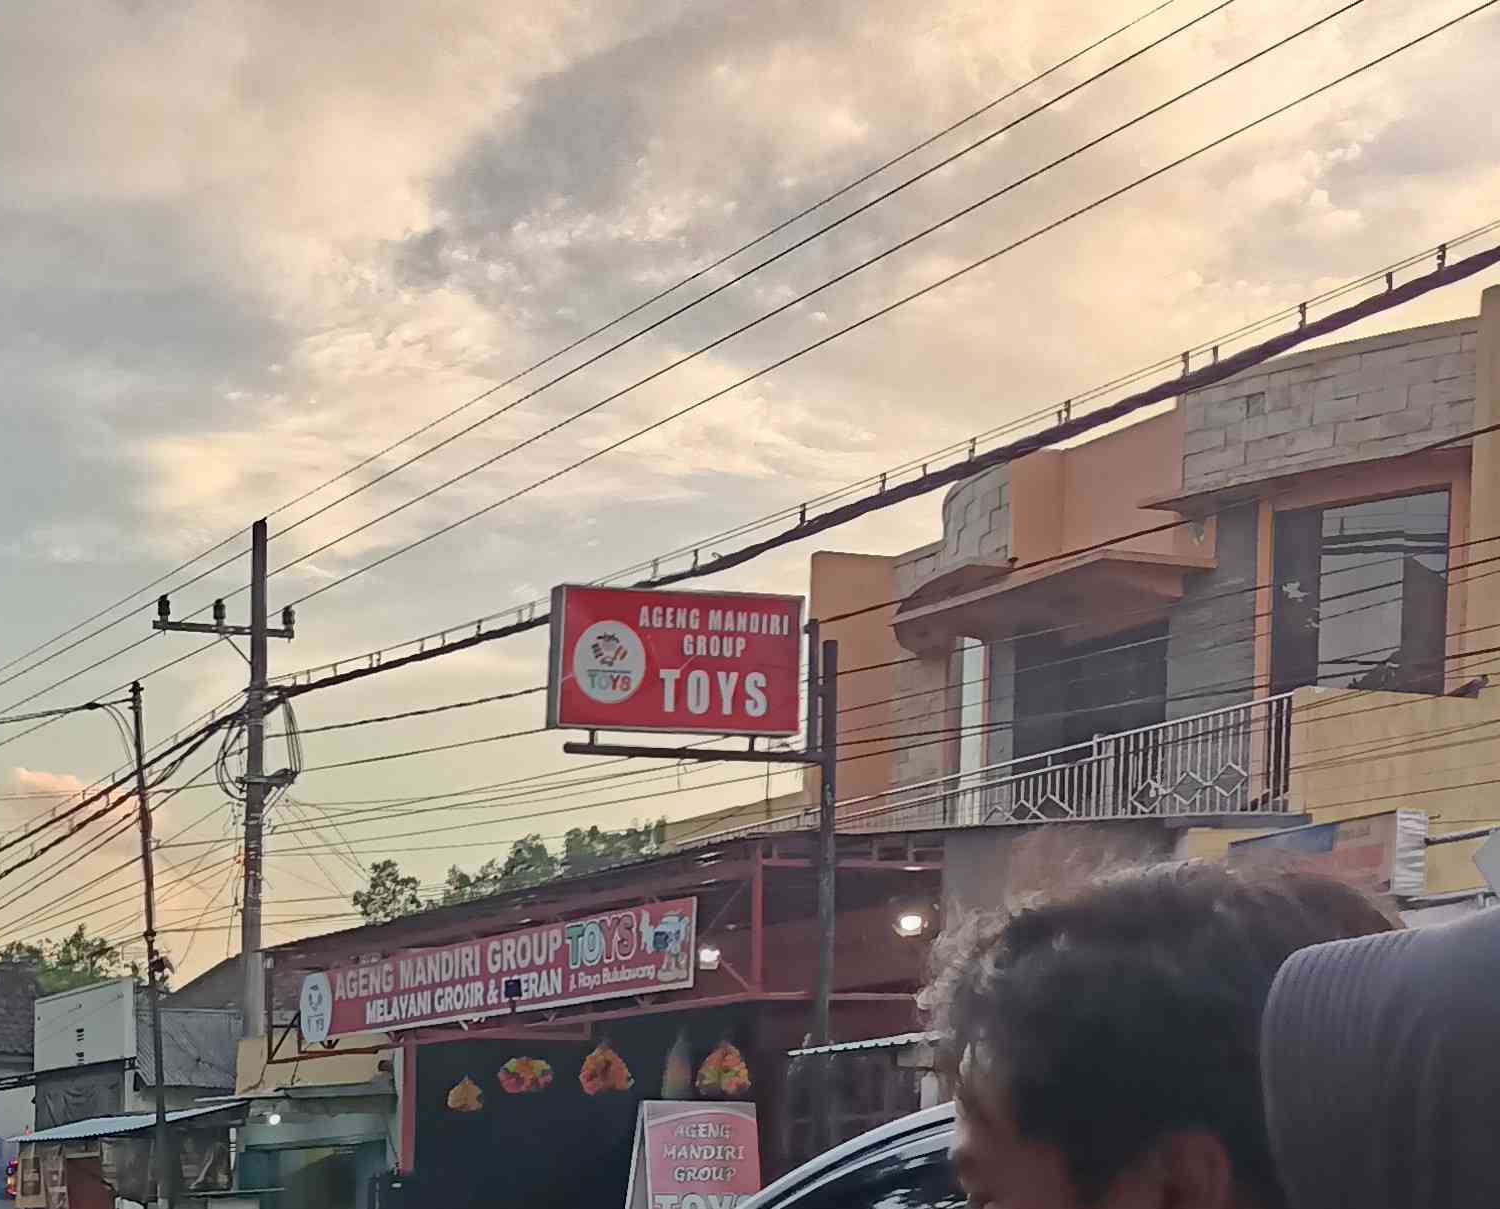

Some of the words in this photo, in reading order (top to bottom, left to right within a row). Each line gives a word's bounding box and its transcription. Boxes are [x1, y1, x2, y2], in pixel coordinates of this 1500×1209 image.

[639, 606, 700, 630] AGENG
[708, 609, 789, 636] MANDIRI
[683, 634, 746, 658] GROUP
[659, 668, 768, 718] TOYS
[335, 963, 394, 1000] AGENG
[400, 944, 481, 989] MANDIRI
[487, 929, 562, 973] GROUP
[565, 911, 637, 969] TOYS
[366, 990, 431, 1024] MELAYANI
[434, 982, 484, 1013] GROSIR
[486, 979, 499, 1004] &
[675, 1122, 732, 1139] AGENG
[663, 1143, 745, 1161] MANDIRI
[674, 1166, 737, 1182] GROUP
